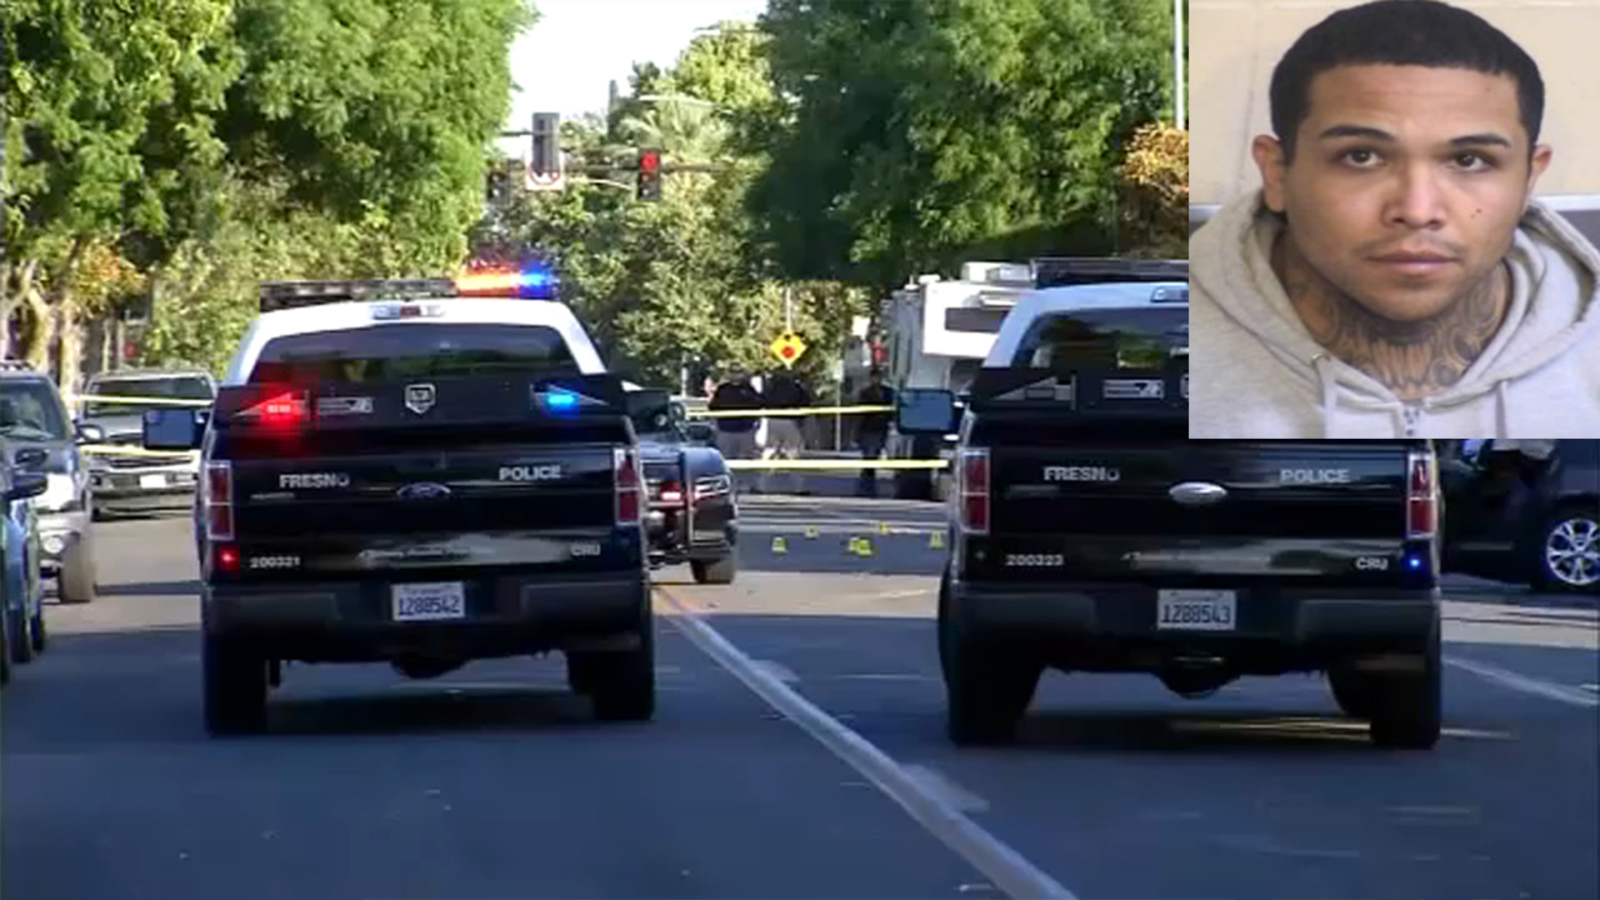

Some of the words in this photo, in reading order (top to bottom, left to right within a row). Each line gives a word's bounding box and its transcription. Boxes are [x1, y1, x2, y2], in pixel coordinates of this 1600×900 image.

[279, 472, 351, 488] FRESNO
[499, 465, 561, 480] POLICE
[1043, 466, 1121, 481] FRESNO
[1280, 468, 1350, 483] POLICE
